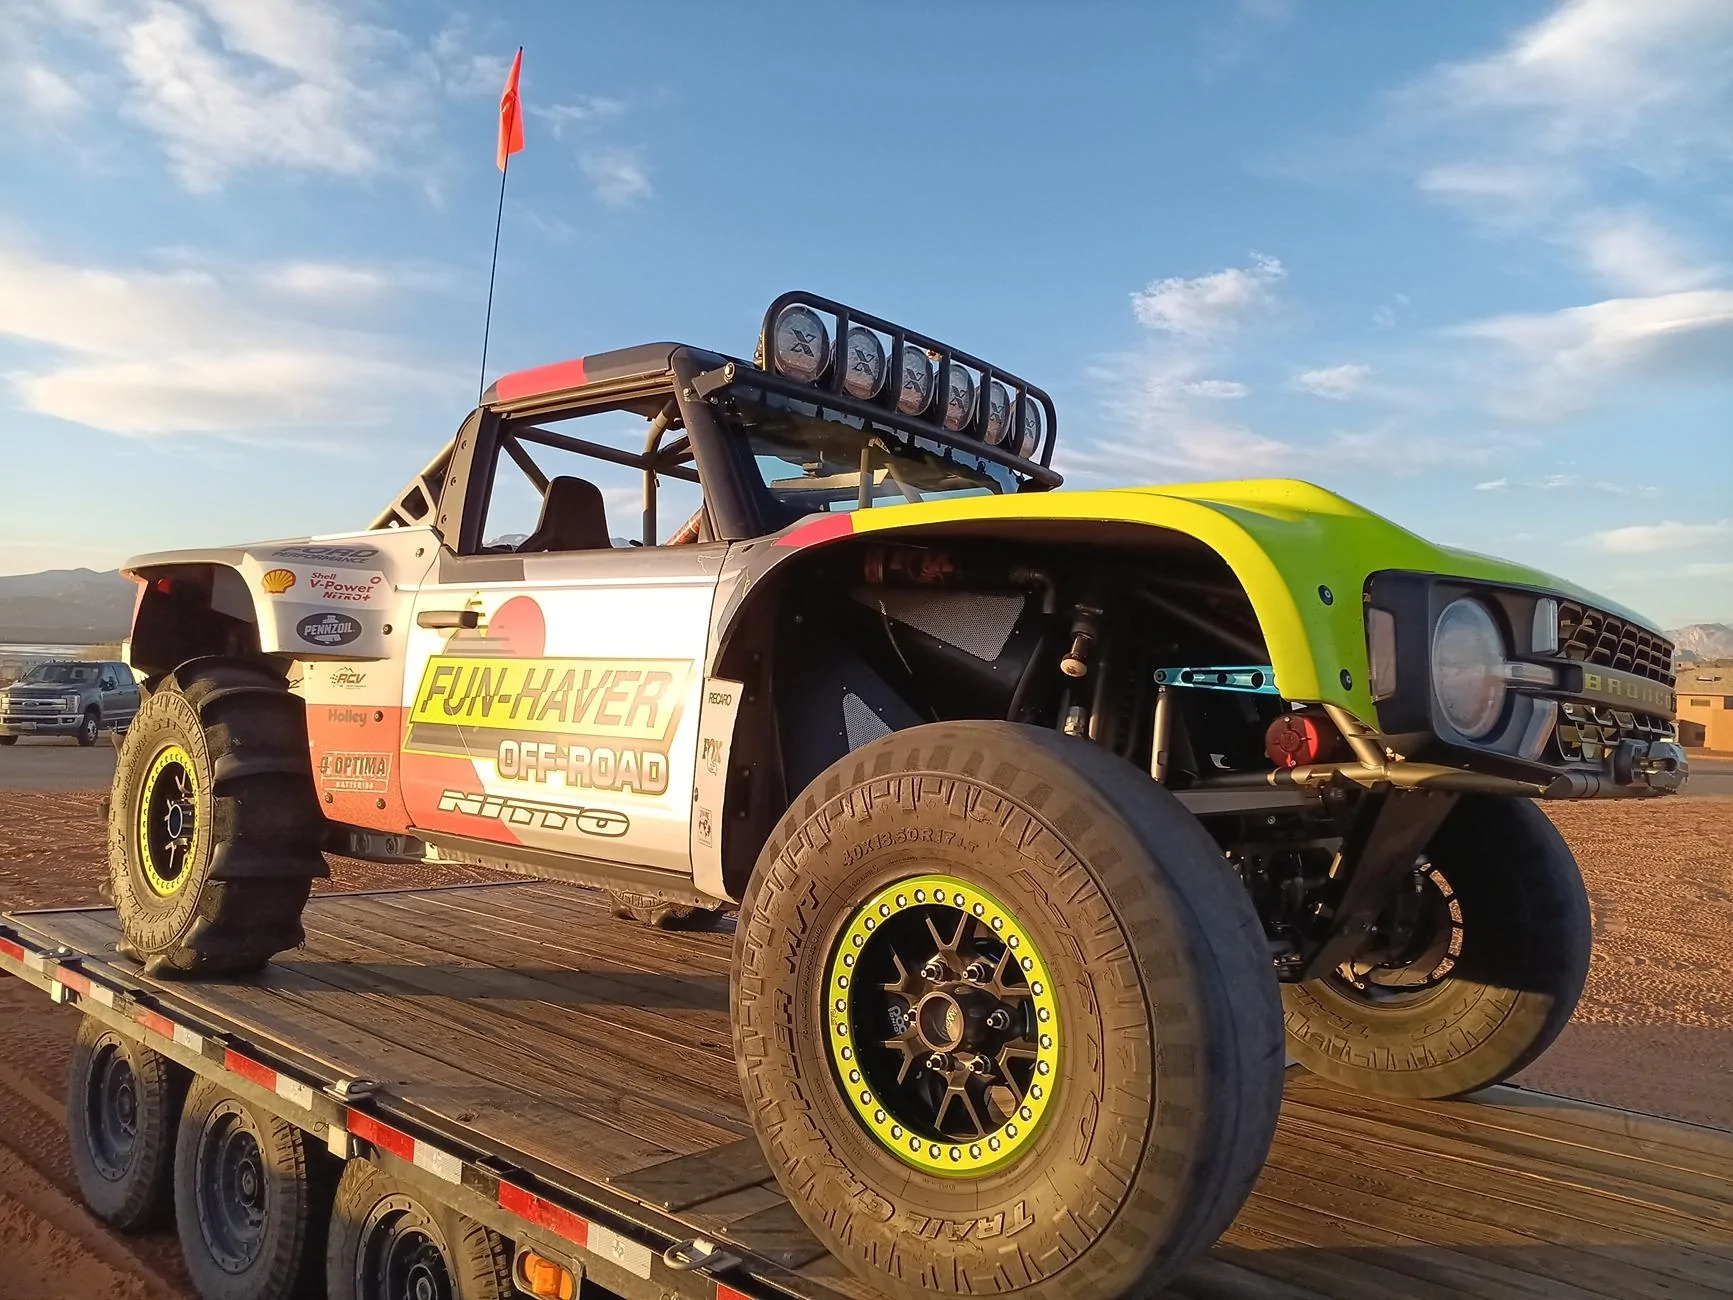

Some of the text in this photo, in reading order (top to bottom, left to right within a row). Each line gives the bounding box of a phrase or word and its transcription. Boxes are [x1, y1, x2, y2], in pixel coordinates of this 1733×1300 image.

[272, 551, 369, 564] PERFORMANCE
[278, 546, 379, 558] FORD
[311, 572, 337, 580] Shell
[310, 579, 374, 592] V-Power
[304, 622, 354, 636] PENNZOIL
[420, 666, 673, 728] FUN-HAVER
[708, 692, 732, 706] RECARO
[1584, 673, 1671, 710] BRONCO
[328, 709, 368, 727] Holley
[334, 756, 387, 777] OPTIMA
[498, 739, 669, 796] OFF-ROAD
[437, 789, 630, 837] NITTO
[774, 879, 1036, 1242] TRAIL GRAPPLER M/T
